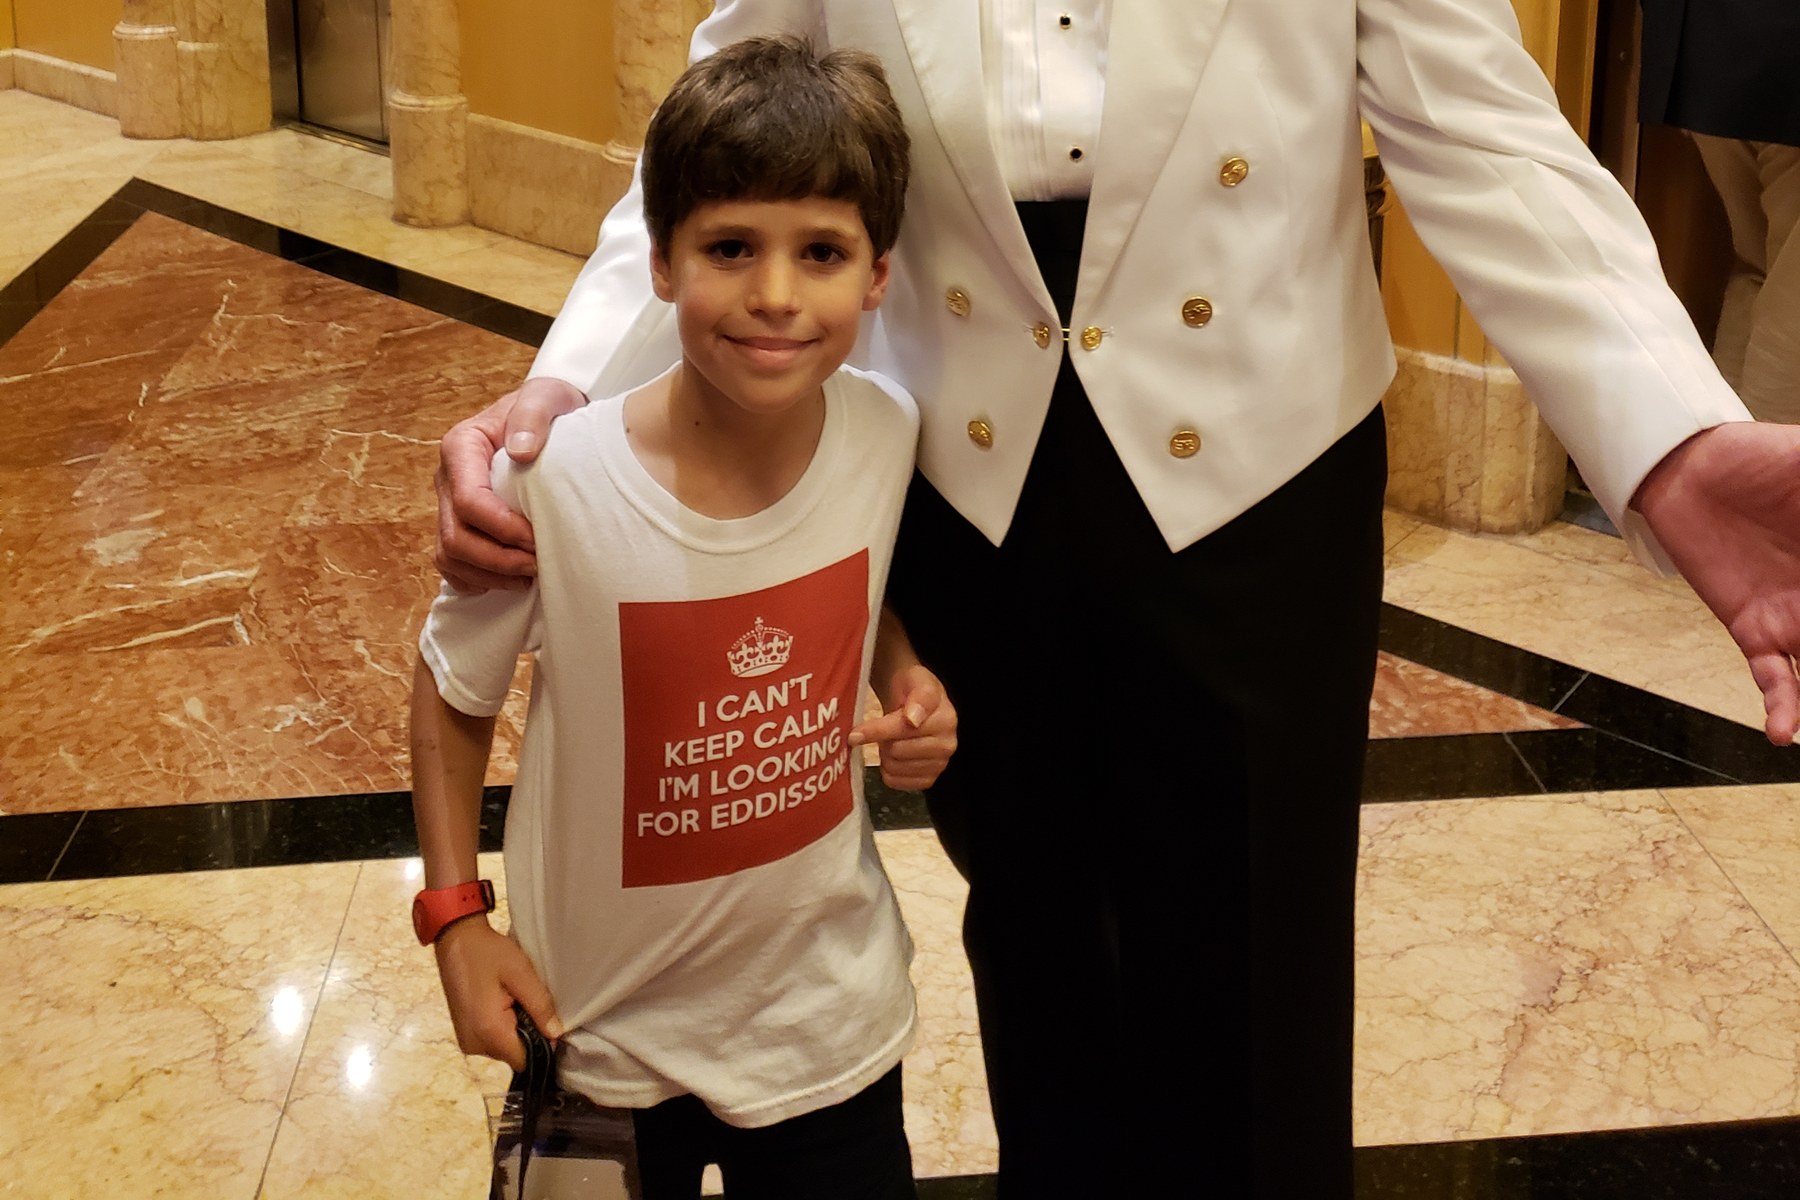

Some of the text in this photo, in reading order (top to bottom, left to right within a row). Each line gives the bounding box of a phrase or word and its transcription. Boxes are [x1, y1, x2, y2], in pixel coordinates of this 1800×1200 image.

[697, 672, 813, 728] I CAN'T
[659, 726, 841, 802] I'M LOOKING
[664, 729, 745, 768] KEEP
[637, 810, 701, 838] FOR
